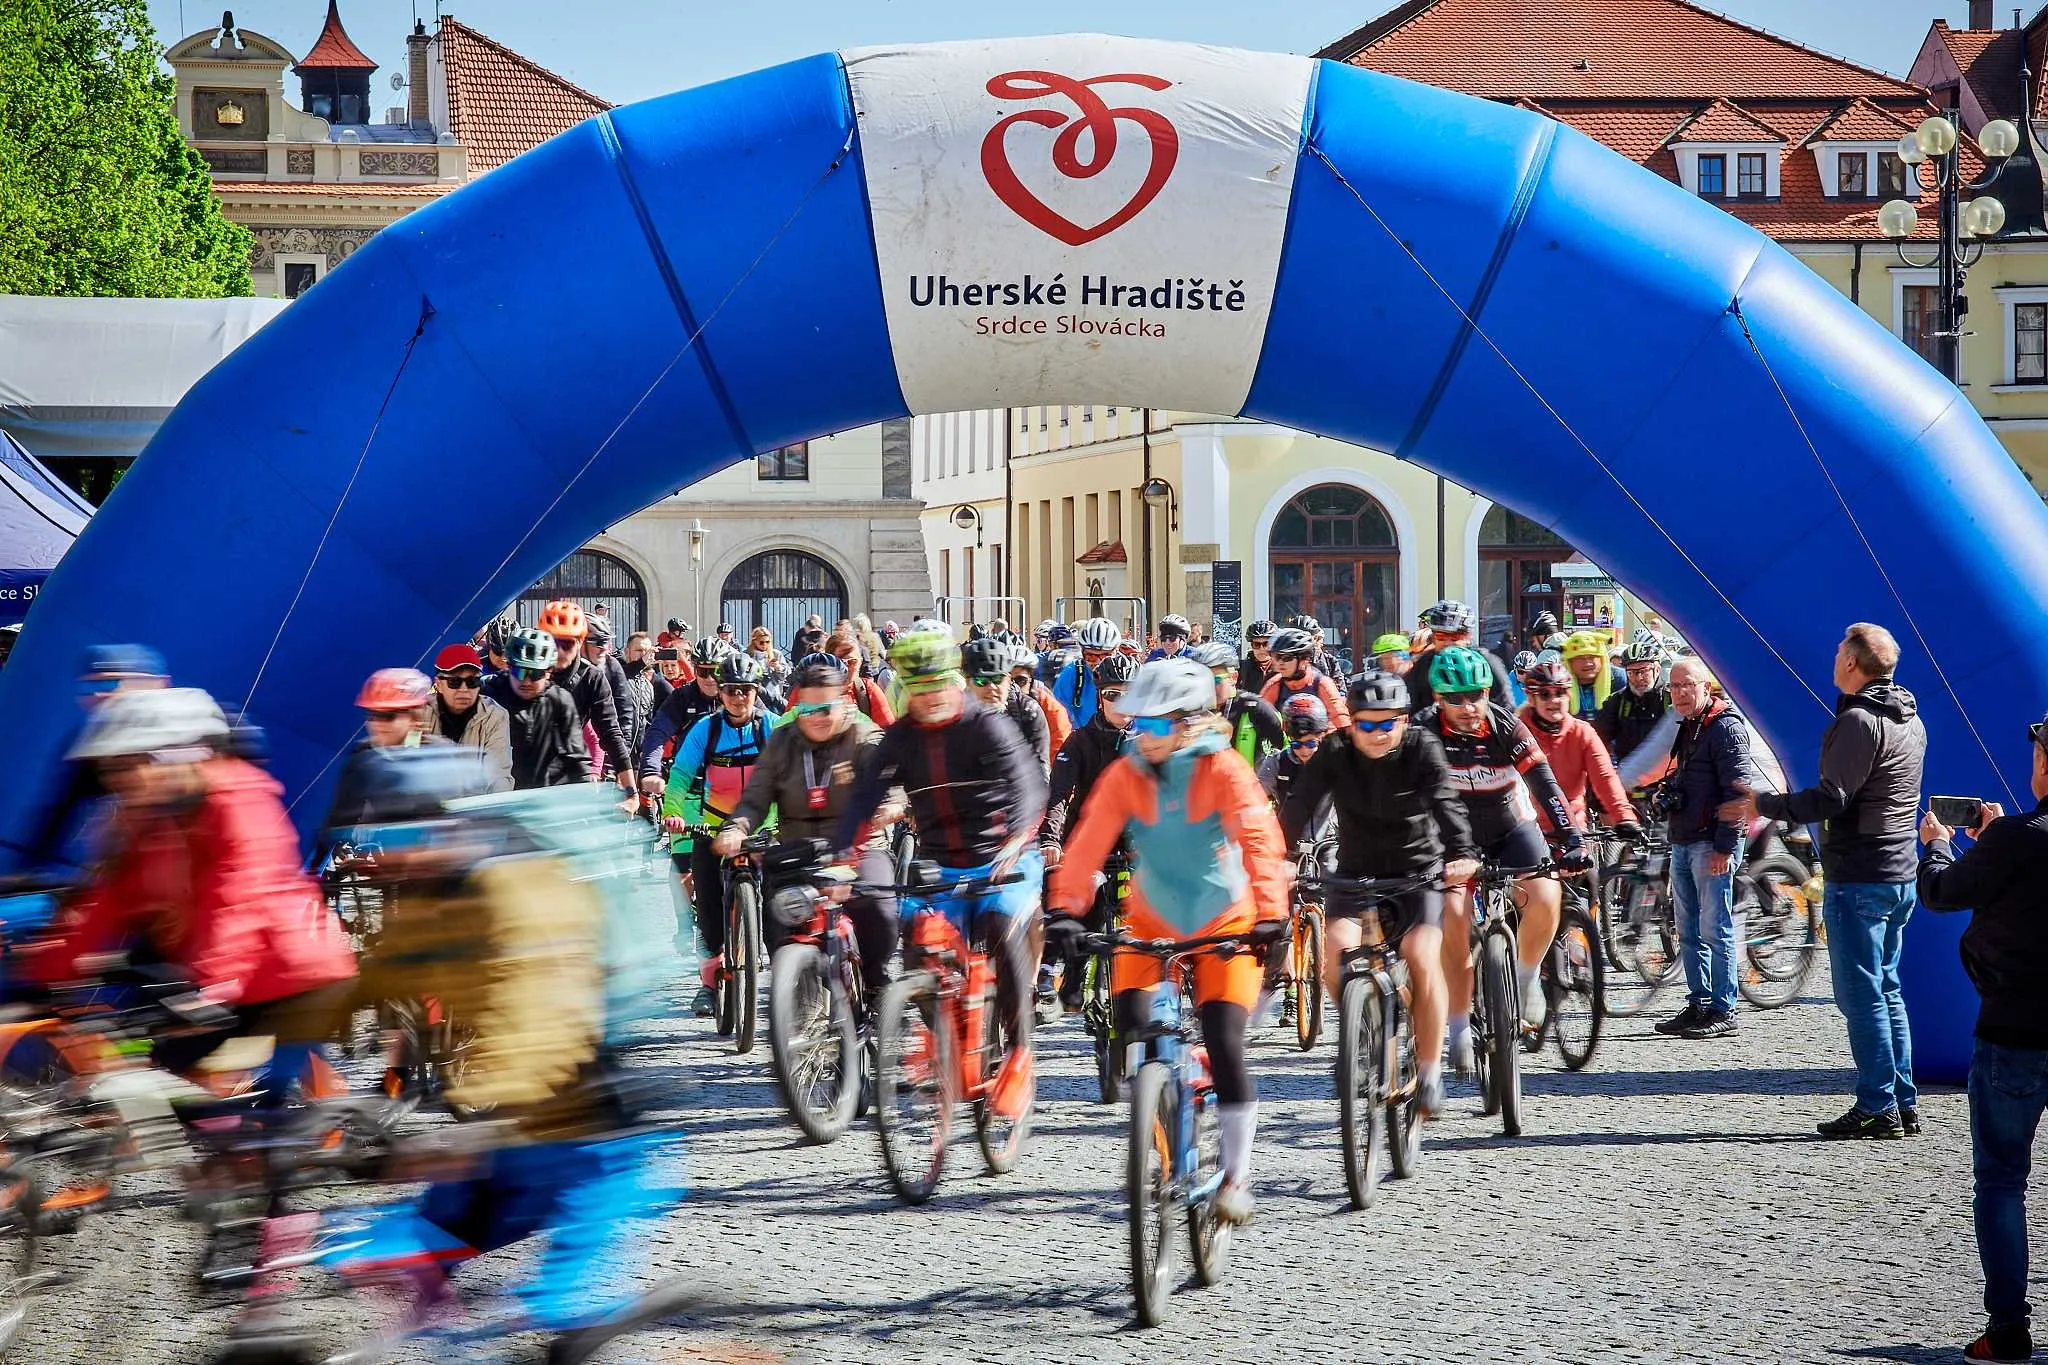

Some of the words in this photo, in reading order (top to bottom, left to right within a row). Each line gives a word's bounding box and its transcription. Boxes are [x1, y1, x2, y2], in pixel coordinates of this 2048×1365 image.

[909, 273, 1067, 306] Uherské
[1082, 275, 1245, 311] Hradiště
[976, 315, 1047, 335] Srdce
[1056, 315, 1165, 337] Slovácka
